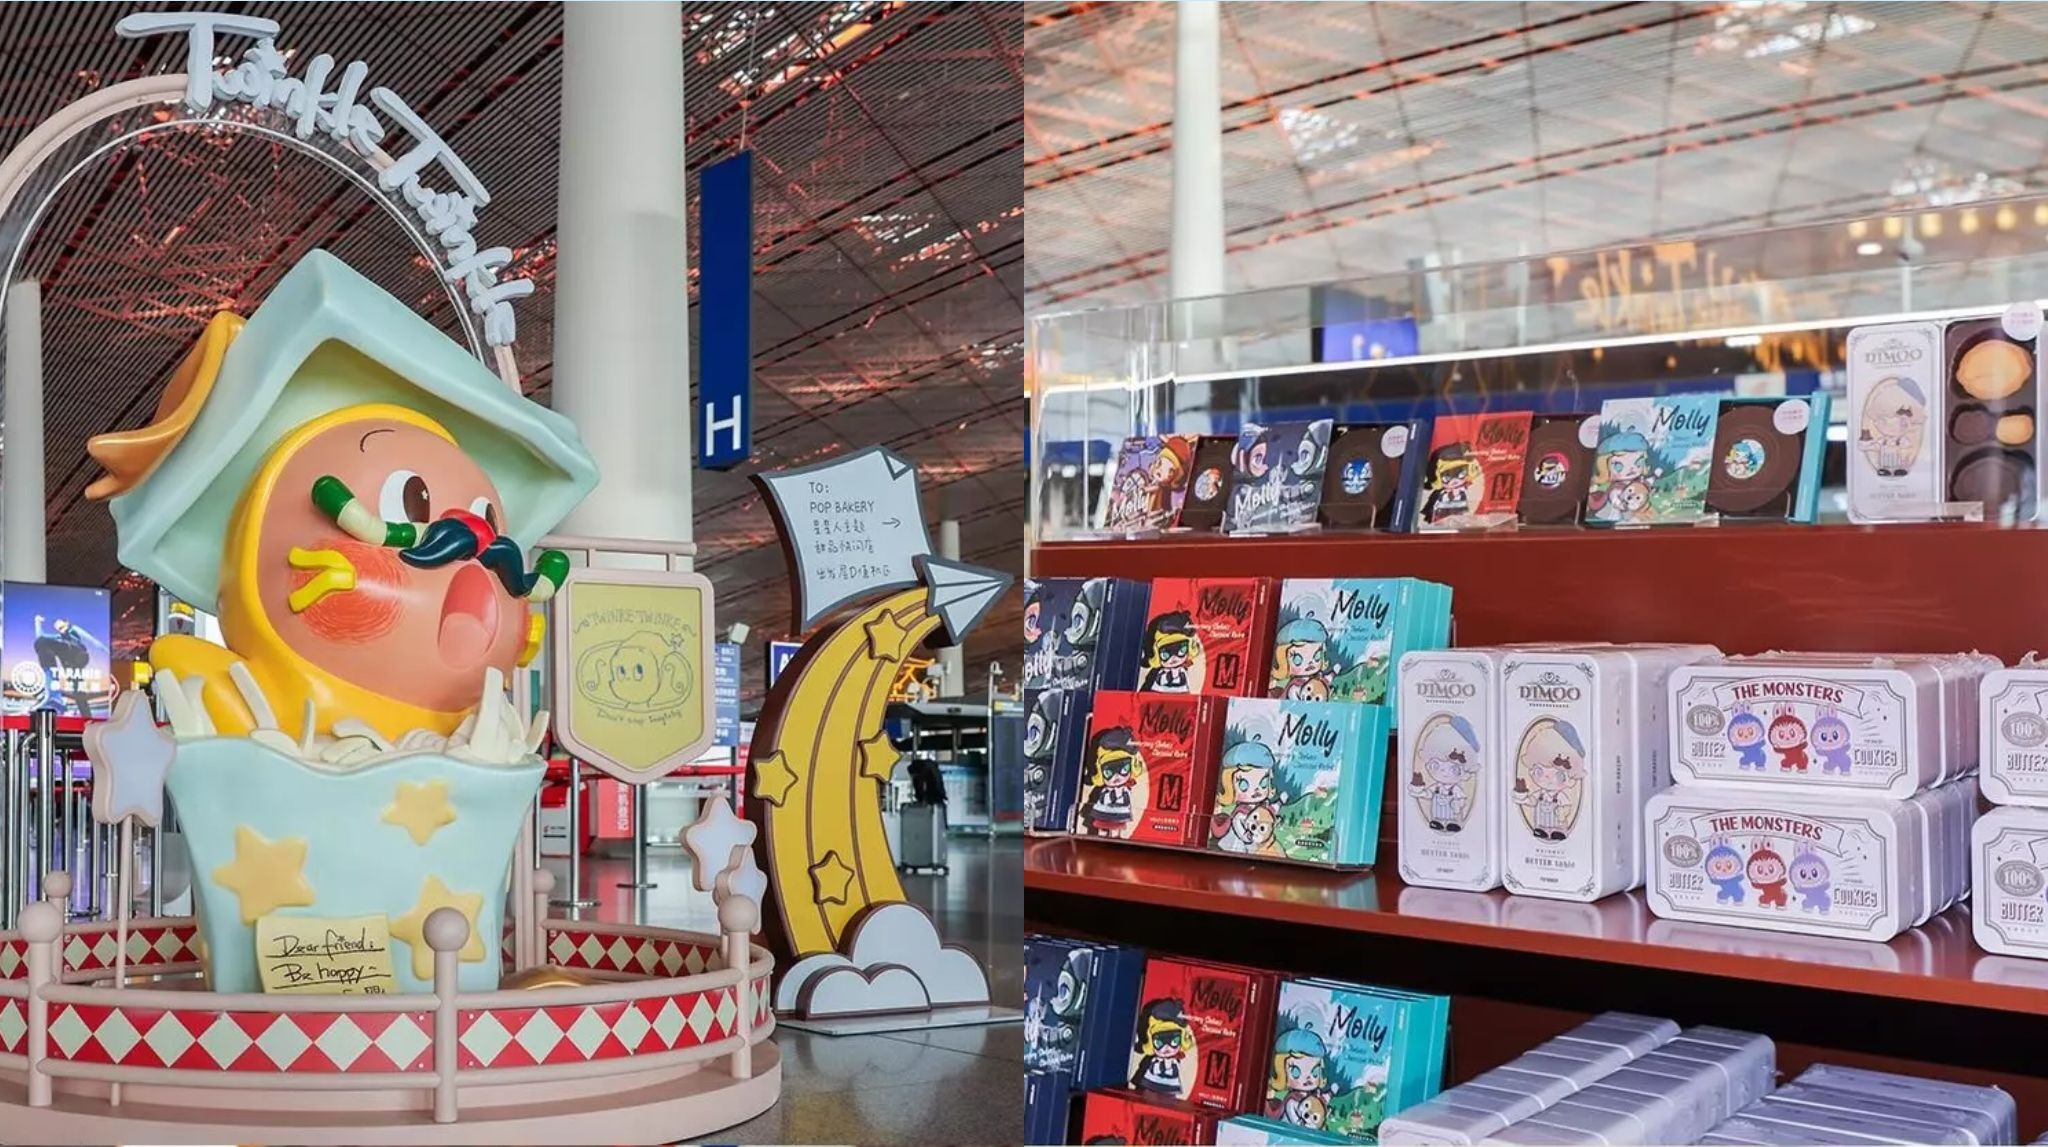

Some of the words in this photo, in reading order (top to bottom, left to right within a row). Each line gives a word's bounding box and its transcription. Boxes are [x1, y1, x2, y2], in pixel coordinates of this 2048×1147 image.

[115, 11, 386, 157] Twinkle
[370, 87, 534, 346] Twinkle
[1865, 348, 1923, 364] DIMOO
[705, 394, 742, 457] H
[1652, 405, 1710, 437] Molly
[808, 481, 830, 494] TO:
[809, 501, 832, 514] POP
[835, 501, 875, 514] BAKERY
[1196, 587, 1250, 625] Molly
[1331, 589, 1390, 628] Molly
[1416, 681, 1476, 698] DIMOO
[1518, 684, 1581, 702] DIMOO
[1731, 683, 1759, 701] THE
[1763, 682, 1844, 703] MONSTERS
[1139, 703, 1192, 743] Molly
[1278, 713, 1339, 757] Molly
[1691, 741, 1726, 759] BUTTER
[1853, 748, 1898, 767] COOKIES
[1710, 816, 1738, 833] THE
[1741, 815, 1823, 840] MONSTERS
[1669, 872, 1704, 891] BUTTER
[1833, 888, 1878, 908] COOKIES
[2000, 902, 2044, 923] BUTTER
[271, 963, 313, 982] Be
[1192, 976, 1241, 1021] Molly
[1330, 1005, 1388, 1052] Molly
[1133, 1114, 1189, 1146] Moll
